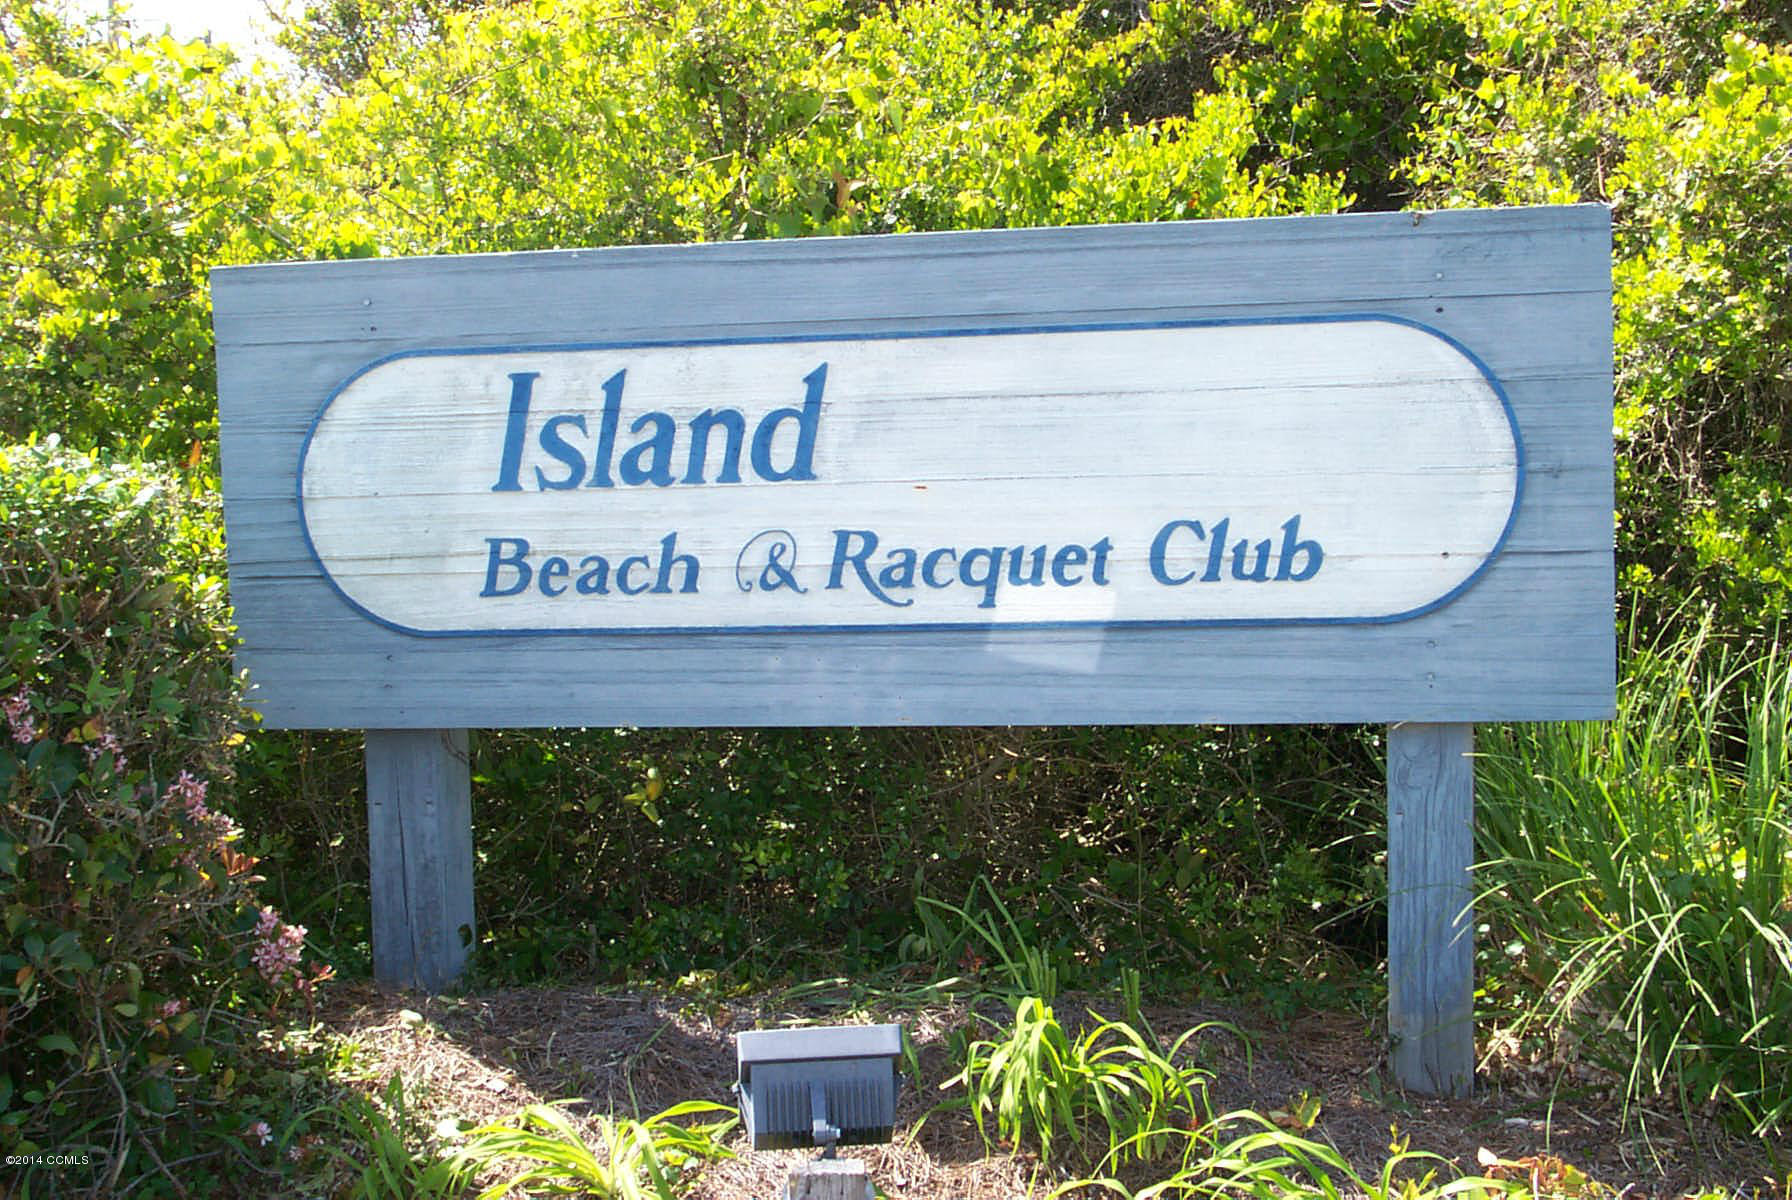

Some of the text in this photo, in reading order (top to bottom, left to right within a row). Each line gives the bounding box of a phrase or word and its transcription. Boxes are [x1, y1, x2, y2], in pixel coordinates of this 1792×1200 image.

[491, 362, 829, 492] Island
[479, 514, 1325, 608] Beach & Racquet Club
